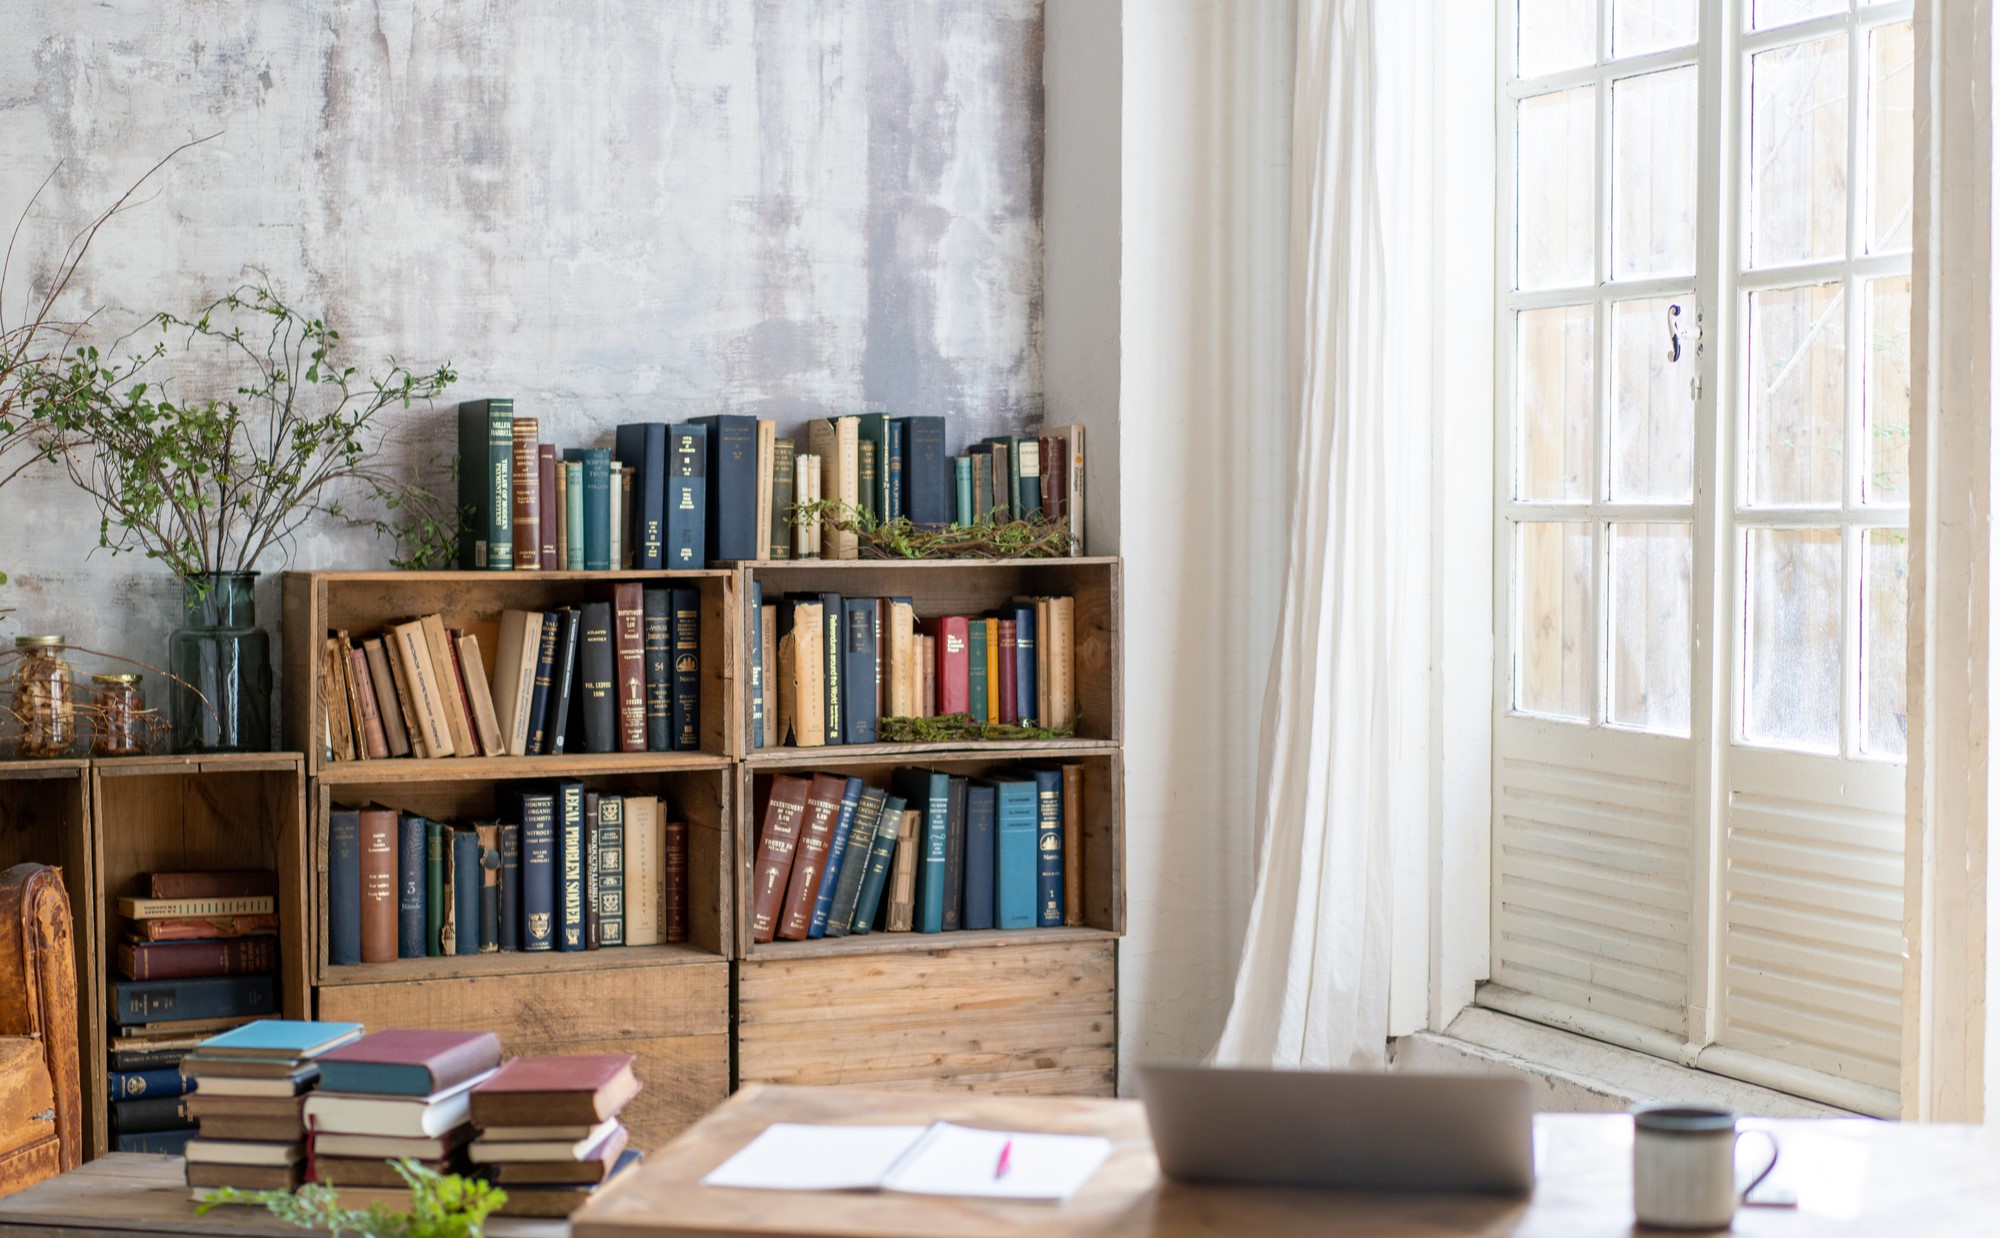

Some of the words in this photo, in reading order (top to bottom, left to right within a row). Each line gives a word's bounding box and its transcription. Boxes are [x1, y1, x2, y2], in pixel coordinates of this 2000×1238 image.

[566, 788, 579, 825] LEGAL
[770, 800, 804, 812] RESTATEMENT
[808, 799, 840, 811] RESTATEMENT
[779, 814, 790, 822] LAW
[764, 838, 784, 847] TRUSTS
[803, 837, 822, 846] TRUSTS
[566, 826, 579, 880] PROBLEM
[407, 882, 415, 894] 3
[566, 881, 580, 924] SOLVER
